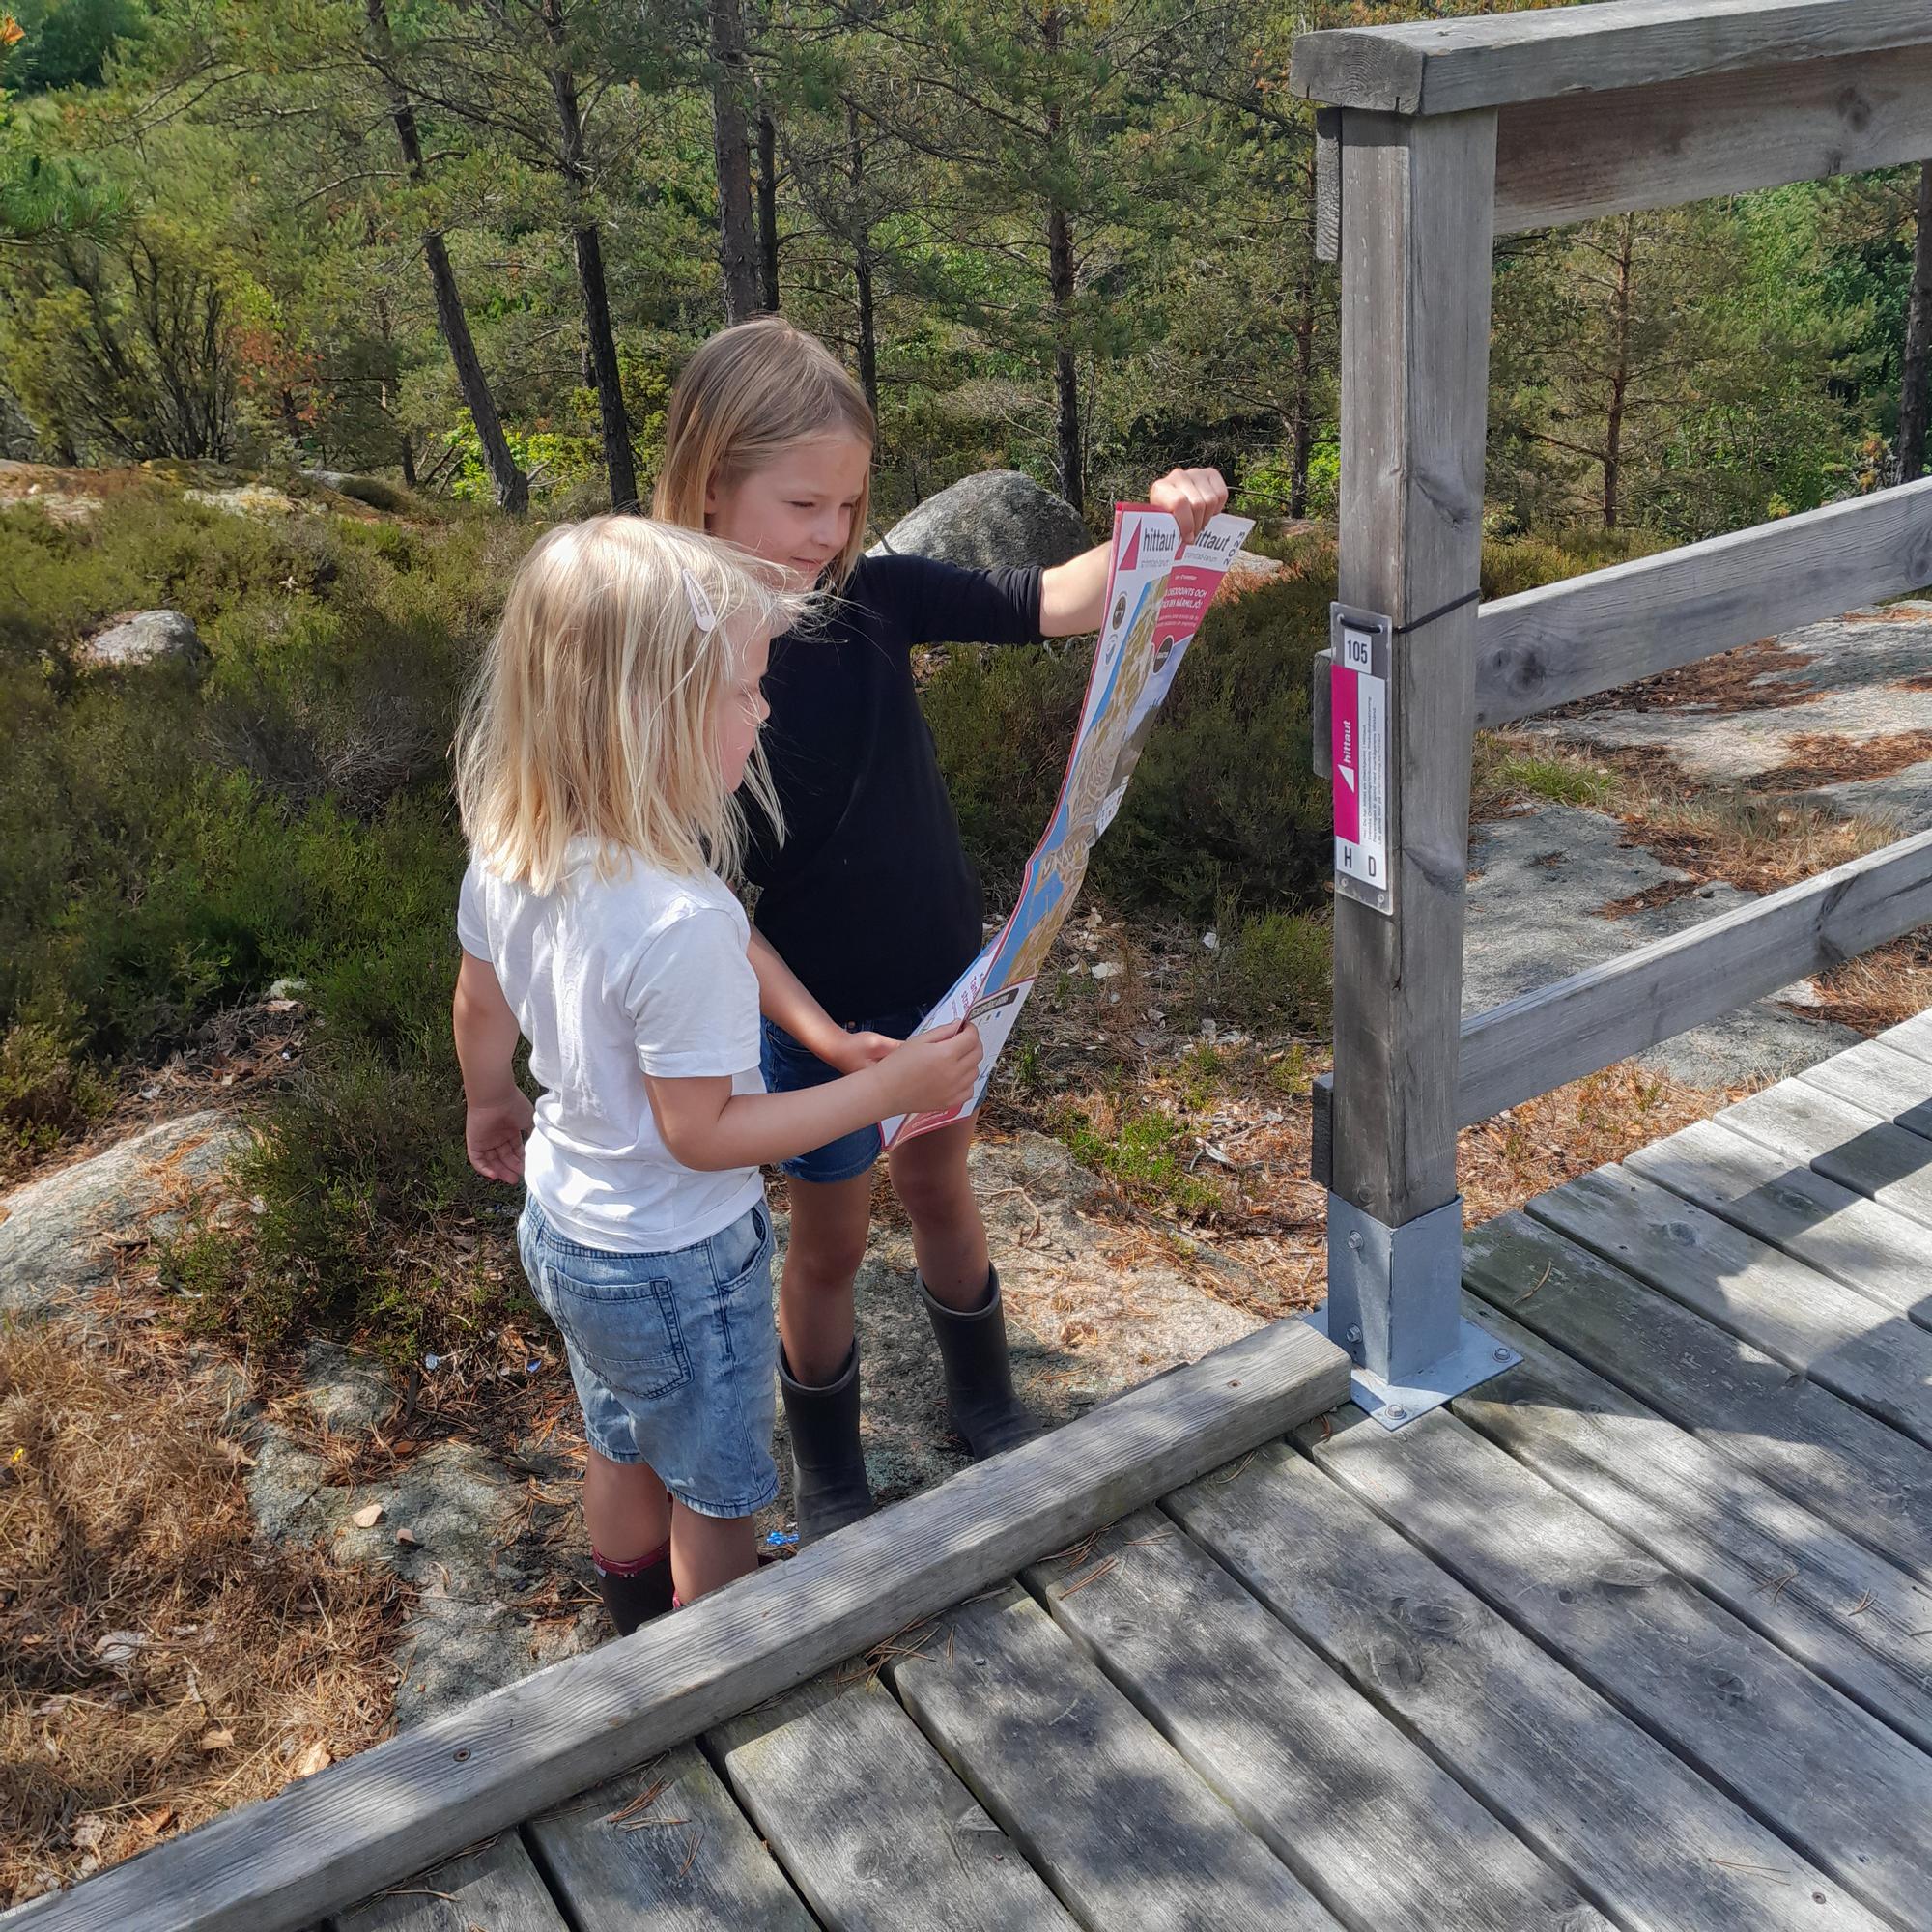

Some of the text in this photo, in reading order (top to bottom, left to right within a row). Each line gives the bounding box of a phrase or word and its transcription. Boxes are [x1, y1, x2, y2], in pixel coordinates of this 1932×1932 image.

[1142, 527, 1176, 552] hittaut
[1195, 530, 1232, 552] ittaut
[1223, 531, 1246, 567] 2023
[1347, 639, 1368, 665] 105
[1343, 720, 1351, 764] hittaut
[1344, 845, 1352, 868] H
[1368, 854, 1377, 878] D
